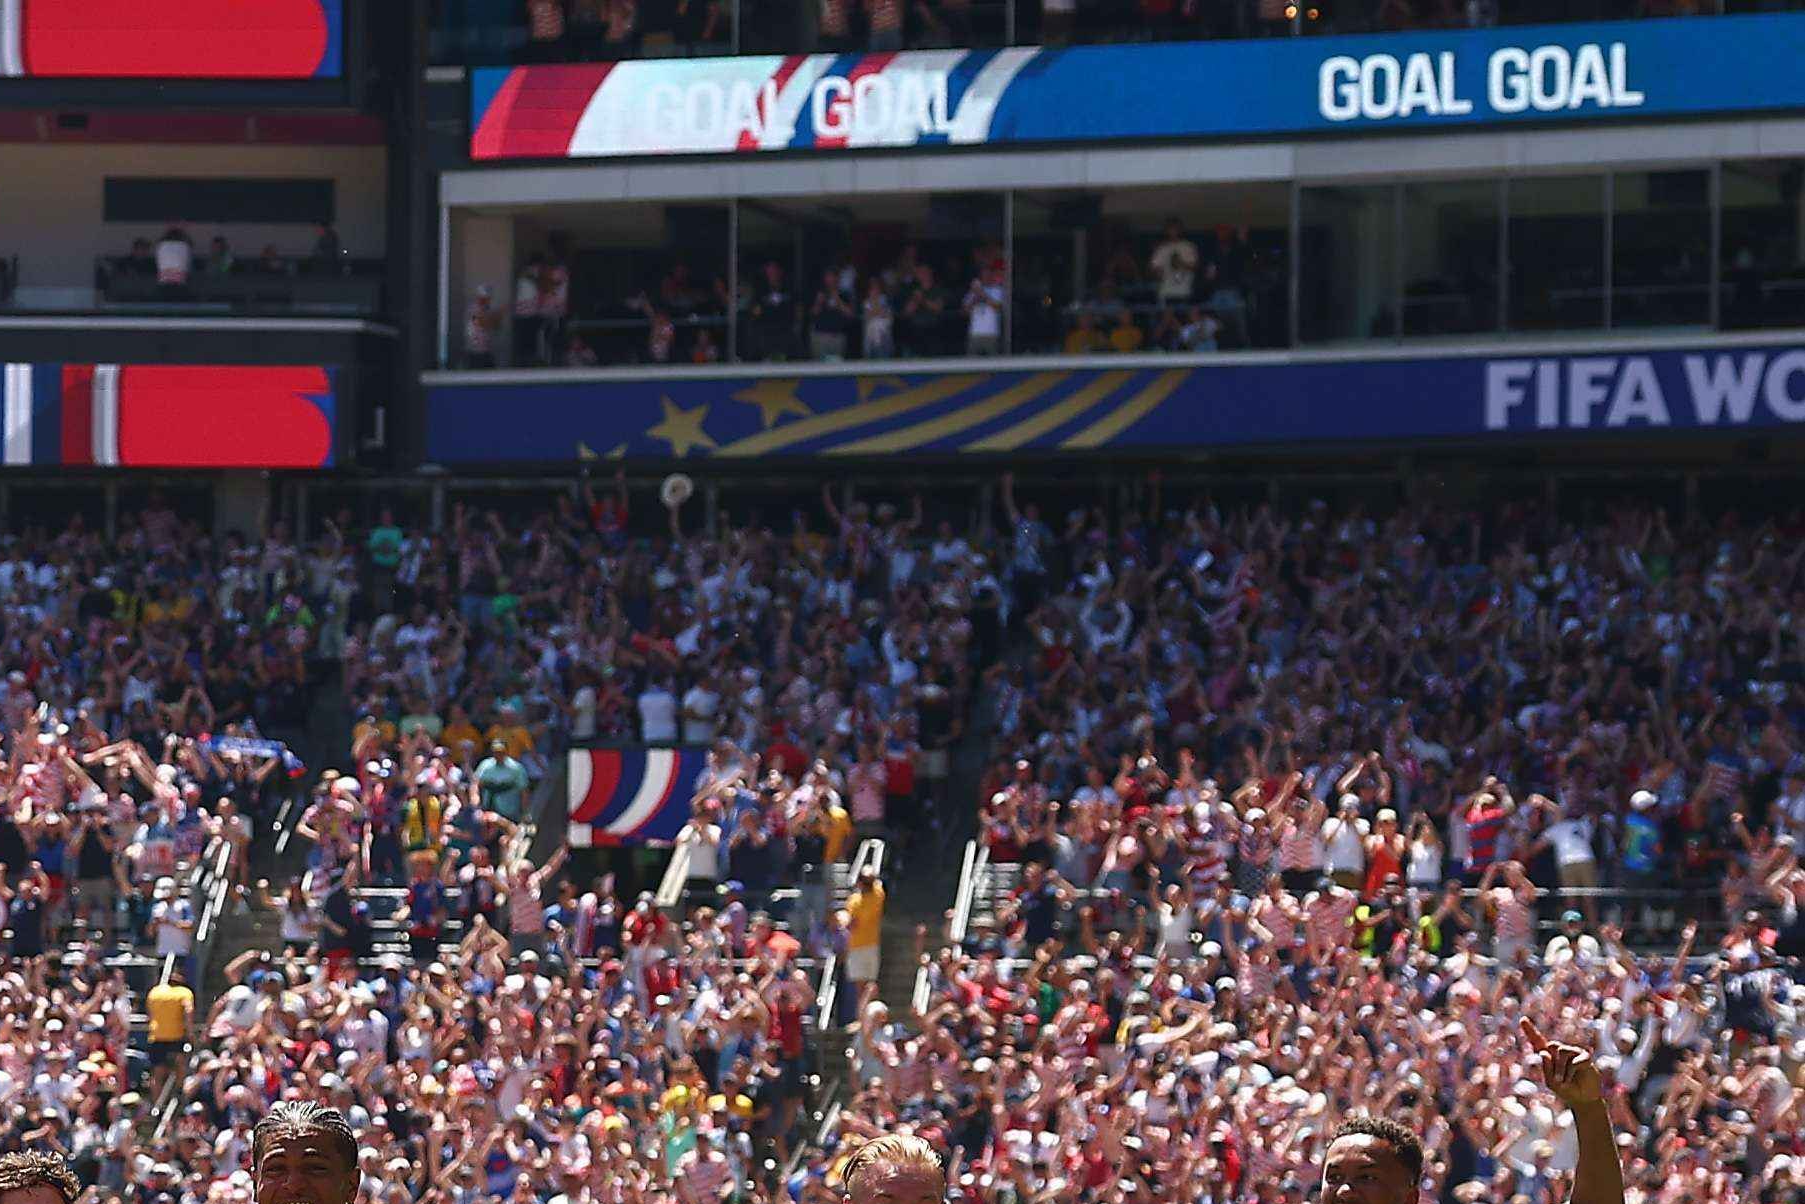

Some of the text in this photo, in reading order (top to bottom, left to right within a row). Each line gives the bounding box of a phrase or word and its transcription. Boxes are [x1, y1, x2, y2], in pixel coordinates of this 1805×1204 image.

[646, 66, 962, 139] GOAL GOAL
[1318, 42, 1644, 121] GOAL GOAL
[1485, 359, 1671, 431] FIFA
